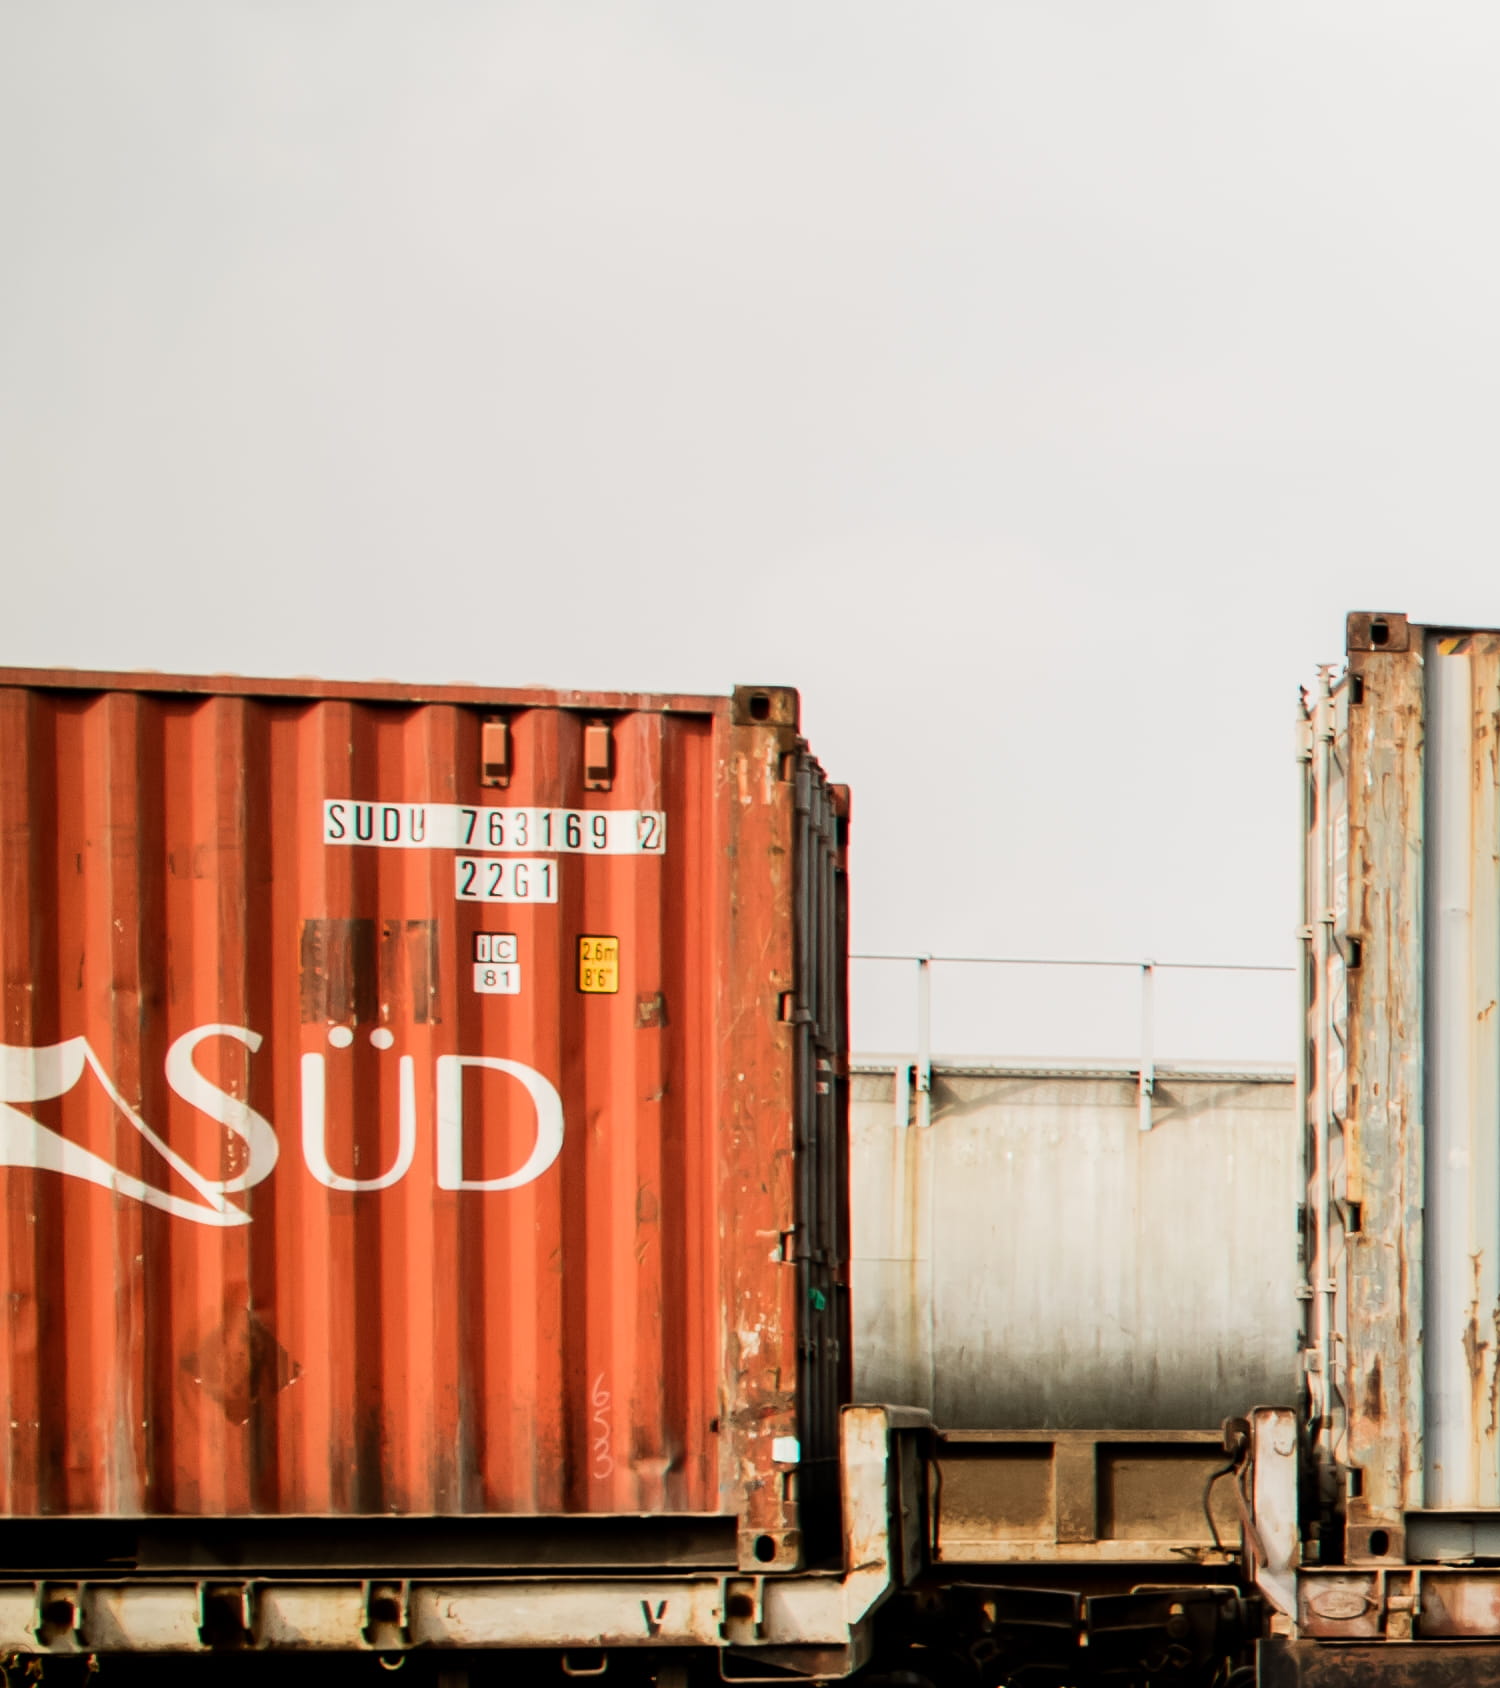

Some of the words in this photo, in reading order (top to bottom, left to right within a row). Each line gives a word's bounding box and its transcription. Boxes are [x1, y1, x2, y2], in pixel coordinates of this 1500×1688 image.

[329, 804, 425, 842] SUDU
[461, 809, 607, 849] 763169
[640, 815, 661, 849] 2
[460, 860, 553, 899] 22G1
[483, 970, 511, 987] 81
[164, 1023, 564, 1194] SÜD
